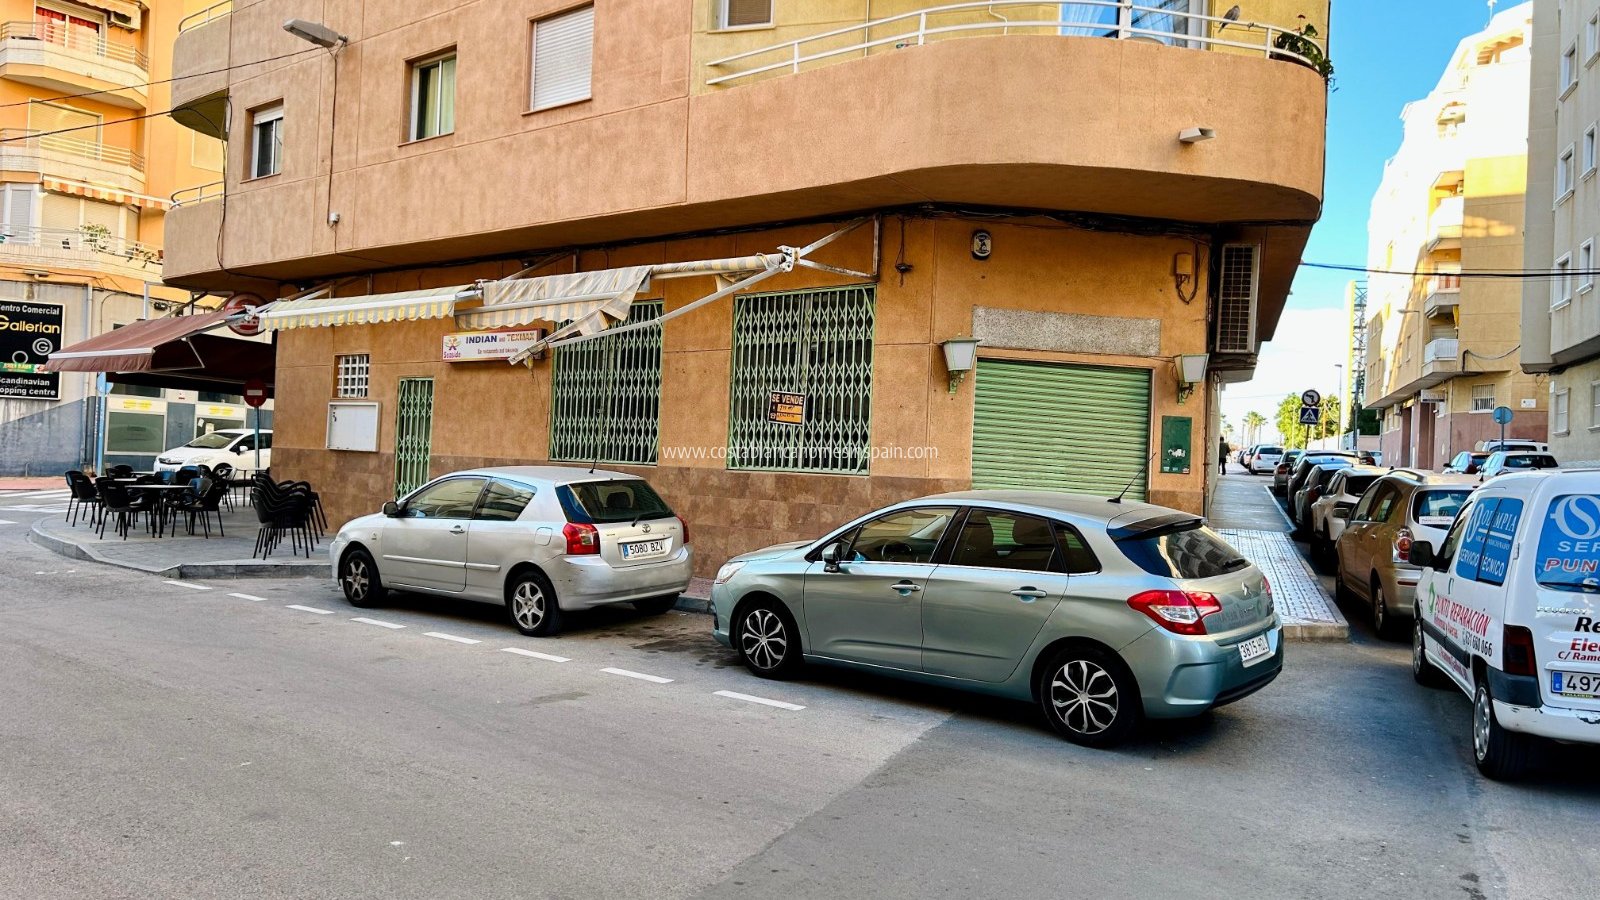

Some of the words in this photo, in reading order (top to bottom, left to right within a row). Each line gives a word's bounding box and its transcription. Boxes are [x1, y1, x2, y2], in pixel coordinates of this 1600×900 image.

[0, 304, 21, 312] entro
[22, 305, 60, 315] Comercial
[0, 314, 61, 334] Gallerian
[465, 335, 498, 344] INDIAN
[0, 377, 50, 386] candinavian
[28, 388, 56, 396] centre
[772, 394, 781, 403] SE
[782, 394, 804, 405] VENDE
[1481, 509, 1518, 532] OLMPIA
[650, 541, 663, 552] BZV
[1543, 557, 1599, 573] PUN
[1537, 606, 1587, 615] PEUGEOT
[1450, 601, 1491, 637] REPARACIÓN
[1566, 675, 1600, 692] 497
